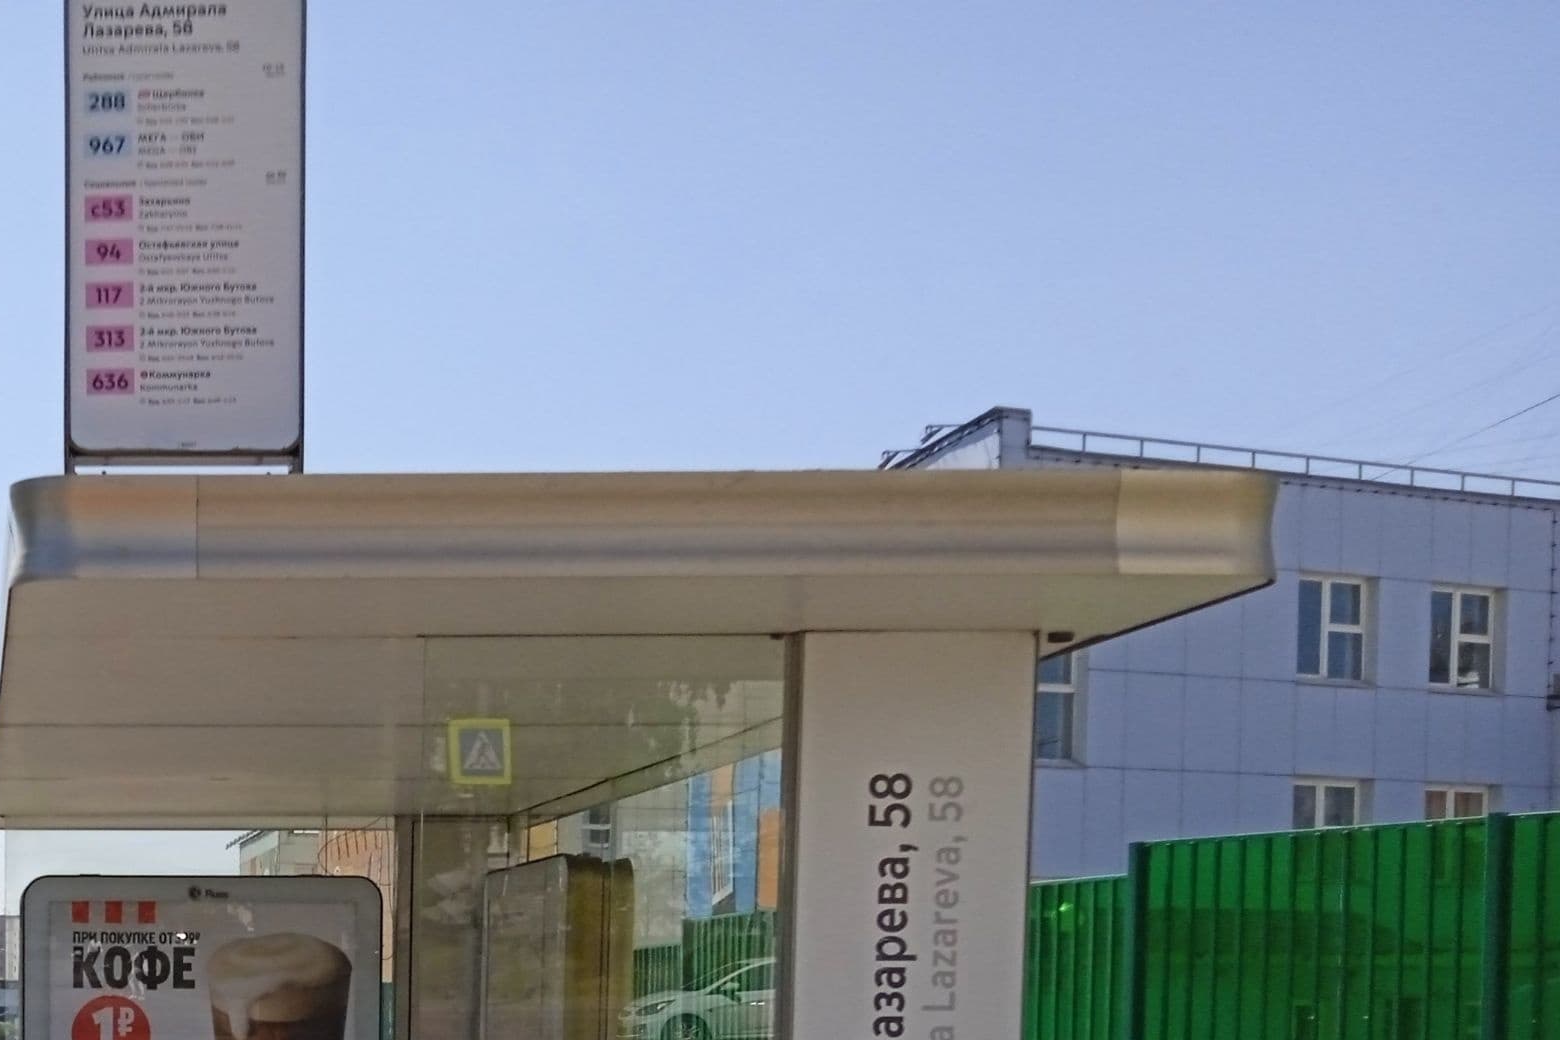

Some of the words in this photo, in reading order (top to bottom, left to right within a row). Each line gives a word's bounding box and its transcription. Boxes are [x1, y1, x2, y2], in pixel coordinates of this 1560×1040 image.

[83, 5, 134, 19] Улица
[140, 3, 227, 20] Адмирала
[83, 22, 168, 38] Лазарева,
[172, 20, 193, 35] 58
[89, 92, 125, 111] 288
[89, 137, 125, 155] 967
[97, 245, 121, 260] 94
[96, 287, 122, 304] 117
[95, 331, 124, 348] 313
[93, 375, 128, 391] 636
[868, 773, 912, 828] 58
[929, 776, 964, 822] 58
[922, 835, 968, 1012] Lazareva,
[72, 931, 98, 945] ПРИ
[100, 931, 155, 945] ПОКУПКЕ
[159, 932, 173, 945] ОТ
[72, 944, 195, 990] КОФЕ
